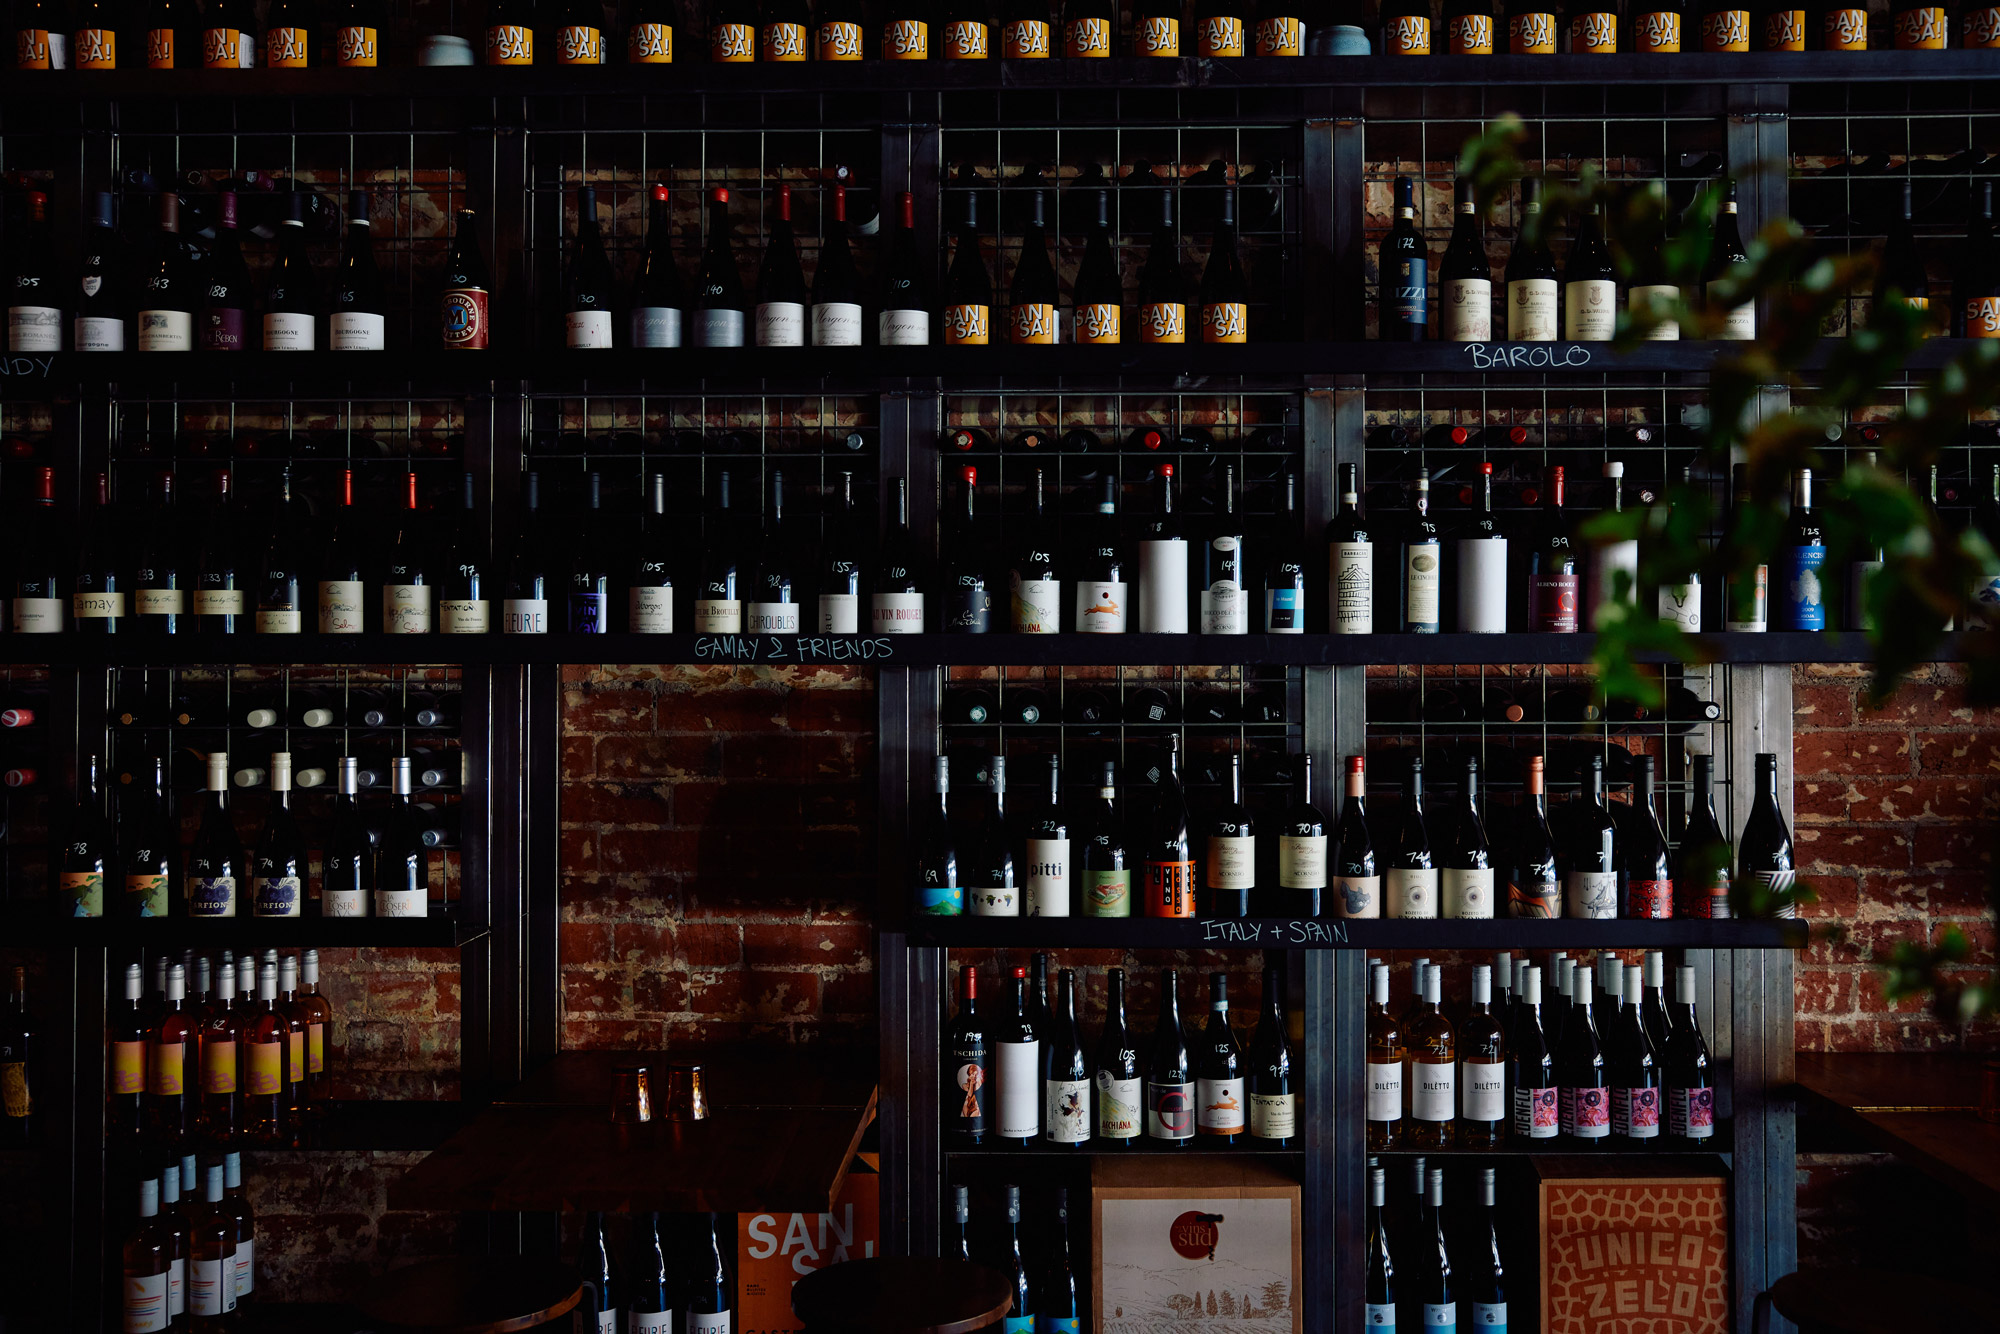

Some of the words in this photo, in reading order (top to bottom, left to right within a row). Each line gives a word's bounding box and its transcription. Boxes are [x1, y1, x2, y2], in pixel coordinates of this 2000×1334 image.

[1145, 31, 1178, 51] SA!
[1209, 31, 1240, 50] SA!
[1400, 30, 1429, 50] SA!
[1462, 28, 1492, 48] SA!
[1586, 26, 1616, 47] SA!
[1649, 26, 1679, 46] SA!
[1717, 25, 1748, 45] SA!
[1904, 22, 1941, 44] SA!
[499, 37, 531, 58] SA!
[639, 37, 669, 57] SA!
[721, 37, 752, 57] SA!
[831, 36, 863, 56] SA!
[895, 34, 926, 54] SA!
[957, 35, 987, 55] SA!
[1076, 31, 1109, 52] SA!
[16, 275, 41, 288] 305
[209, 285, 227, 298] 188
[706, 284, 724, 298] 140
[449, 310, 464, 326] M
[955, 320, 987, 339] SA!
[1018, 318, 1050, 338] SA!
[1087, 317, 1118, 337] SA!
[1153, 317, 1183, 337] SA!
[1214, 317, 1246, 337] SA!
[1464, 342, 1591, 369] BAROLO
[1421, 521, 1437, 533] 95
[1480, 520, 1494, 531] 98
[1801, 526, 1820, 537] 125
[1551, 536, 1570, 548] 89
[1029, 550, 1050, 563] 105
[1098, 547, 1114, 557] 125
[269, 570, 285, 579] 110
[459, 564, 476, 578] 97
[891, 567, 906, 579] 110
[1280, 562, 1301, 573] 105
[573, 573, 590, 588] 94
[708, 581, 727, 593] 126
[505, 612, 541, 633] FLEURIE
[749, 614, 795, 630] CHIROUBLES
[880, 609, 894, 620] VIN
[896, 609, 923, 620] ROUGE!
[695, 635, 760, 661] GAMAY
[797, 637, 894, 662] FRIENDS
[1219, 822, 1236, 833] 70
[1296, 822, 1311, 834] 70
[73, 842, 88, 855] 78
[136, 849, 151, 863] 78
[196, 858, 210, 870] 74
[259, 857, 273, 869] 74
[1031, 862, 1062, 878] pitti
[1346, 862, 1362, 875] 70
[925, 868, 939, 884] 69
[1200, 919, 1262, 942] ITALY
[1270, 925, 1284, 940] +
[1288, 920, 1349, 944] SPAIN
[953, 1049, 987, 1057] TSCHIDA
[1118, 1049, 1136, 1061] 105
[1214, 1043, 1230, 1054] 125
[1374, 1080, 1400, 1090] DILÉTTO
[1423, 1080, 1450, 1090] DILÉTTO
[1474, 1080, 1501, 1090] DILÉTTO
[1183, 1221, 1206, 1234] vins
[1178, 1227, 1213, 1247] sud
[1578, 1231, 1705, 1270] UNICO
[1583, 1279, 1699, 1318] ZELO
